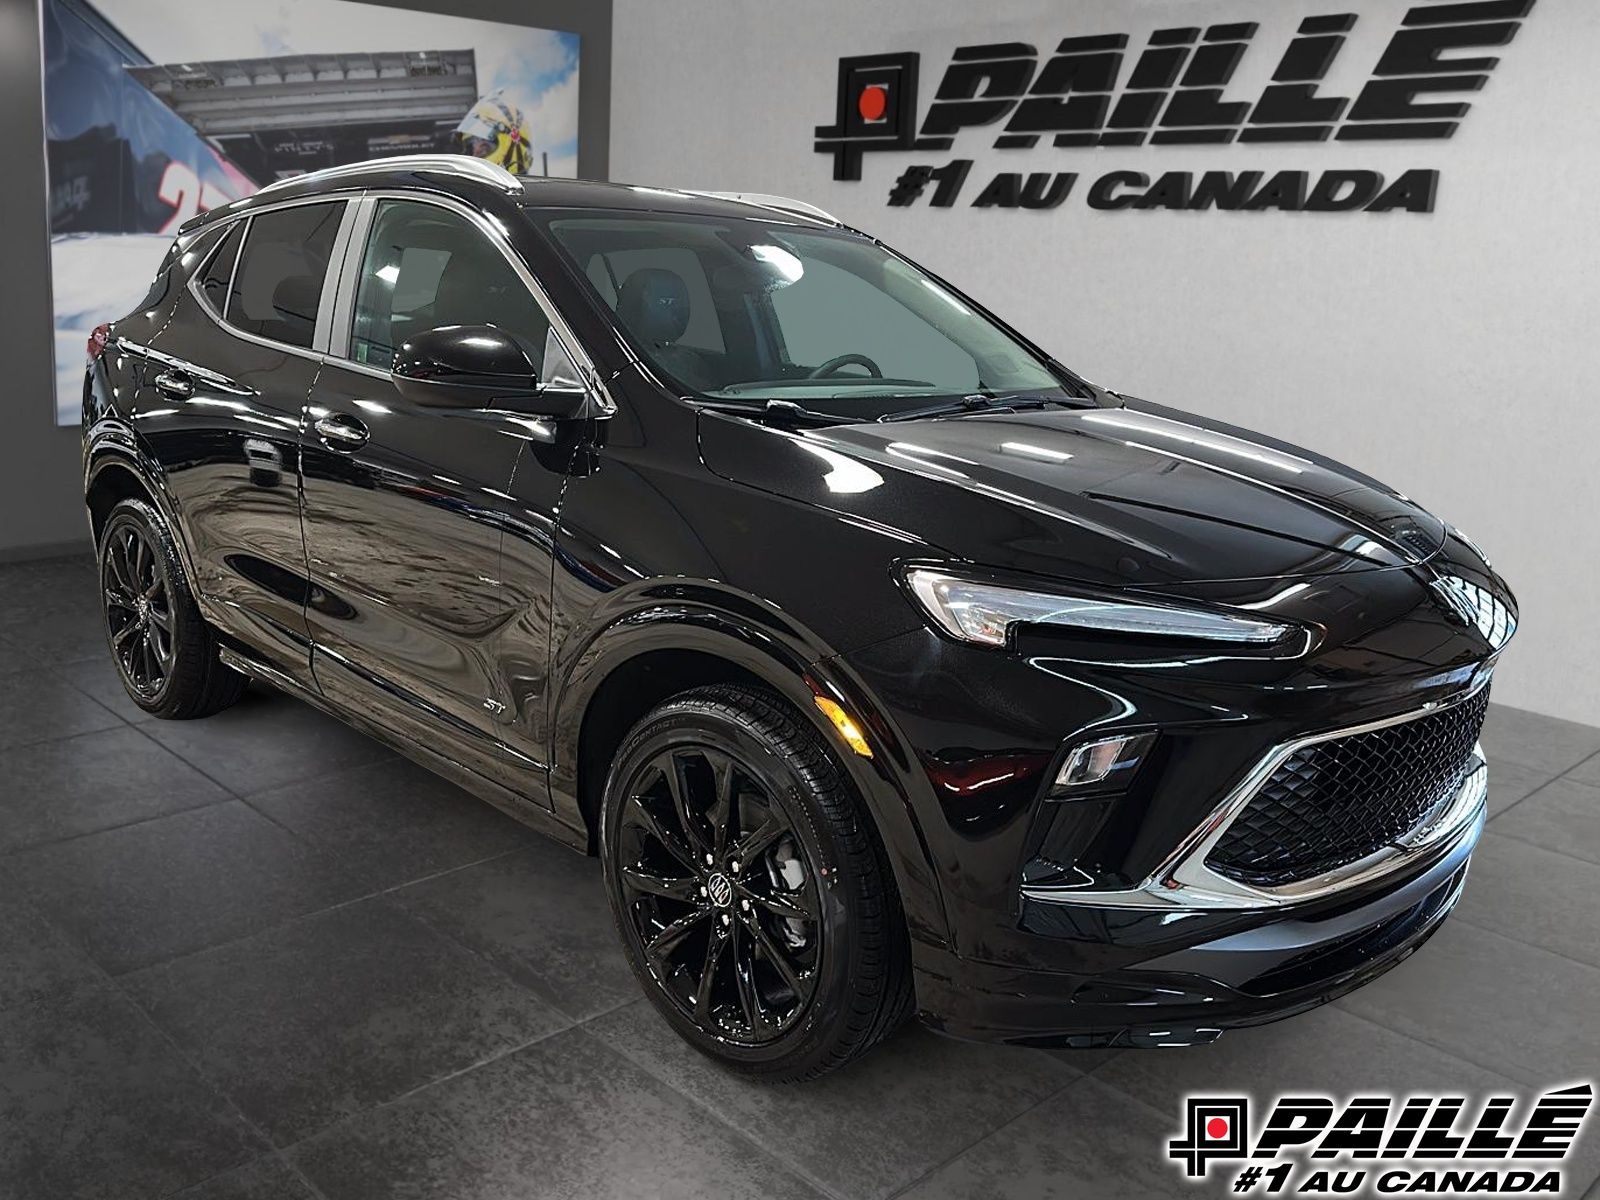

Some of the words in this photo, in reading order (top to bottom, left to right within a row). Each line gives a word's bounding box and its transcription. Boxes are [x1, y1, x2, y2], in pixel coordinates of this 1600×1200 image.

[887, 159, 974, 207] #1
[970, 172, 1079, 209] AU
[1086, 169, 1440, 212] CANADA
